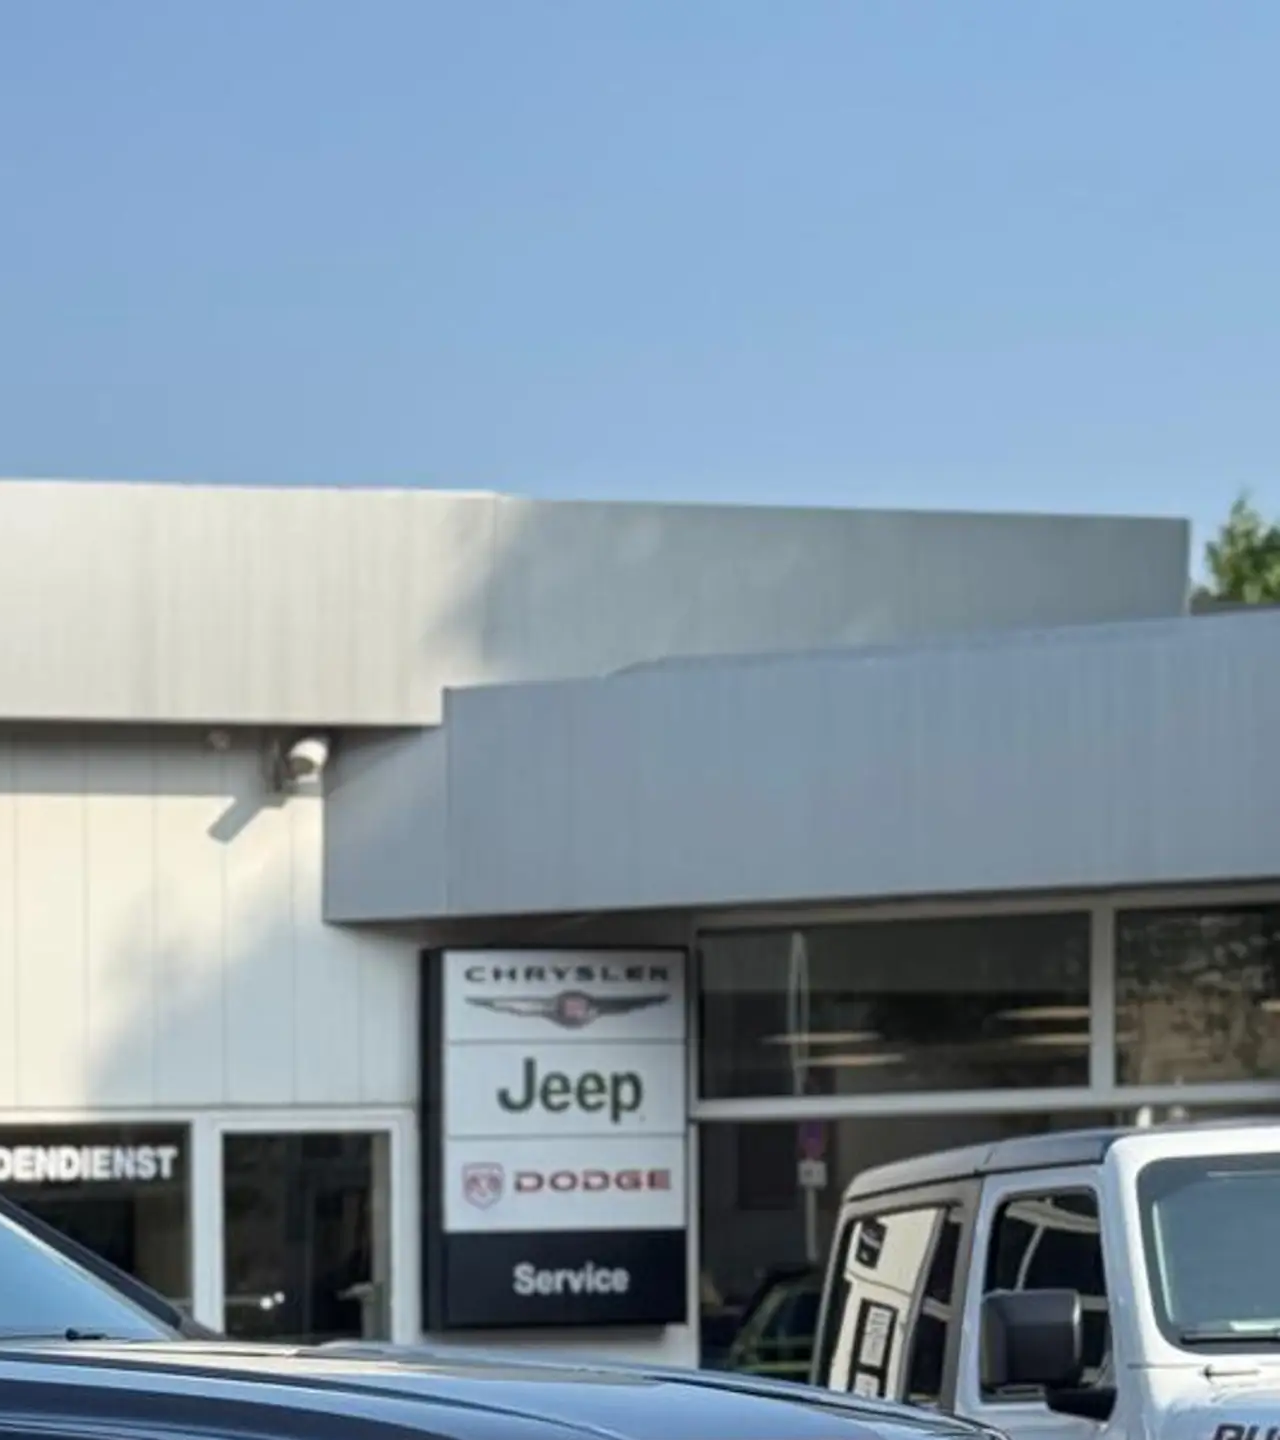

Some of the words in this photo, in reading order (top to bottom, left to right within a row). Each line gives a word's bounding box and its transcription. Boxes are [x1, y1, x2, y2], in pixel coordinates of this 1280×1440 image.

[464, 965, 670, 983] CHRYSLER
[497, 1057, 643, 1124] Jeep
[514, 1169, 671, 1193] DODGE
[513, 1262, 630, 1295] Service
